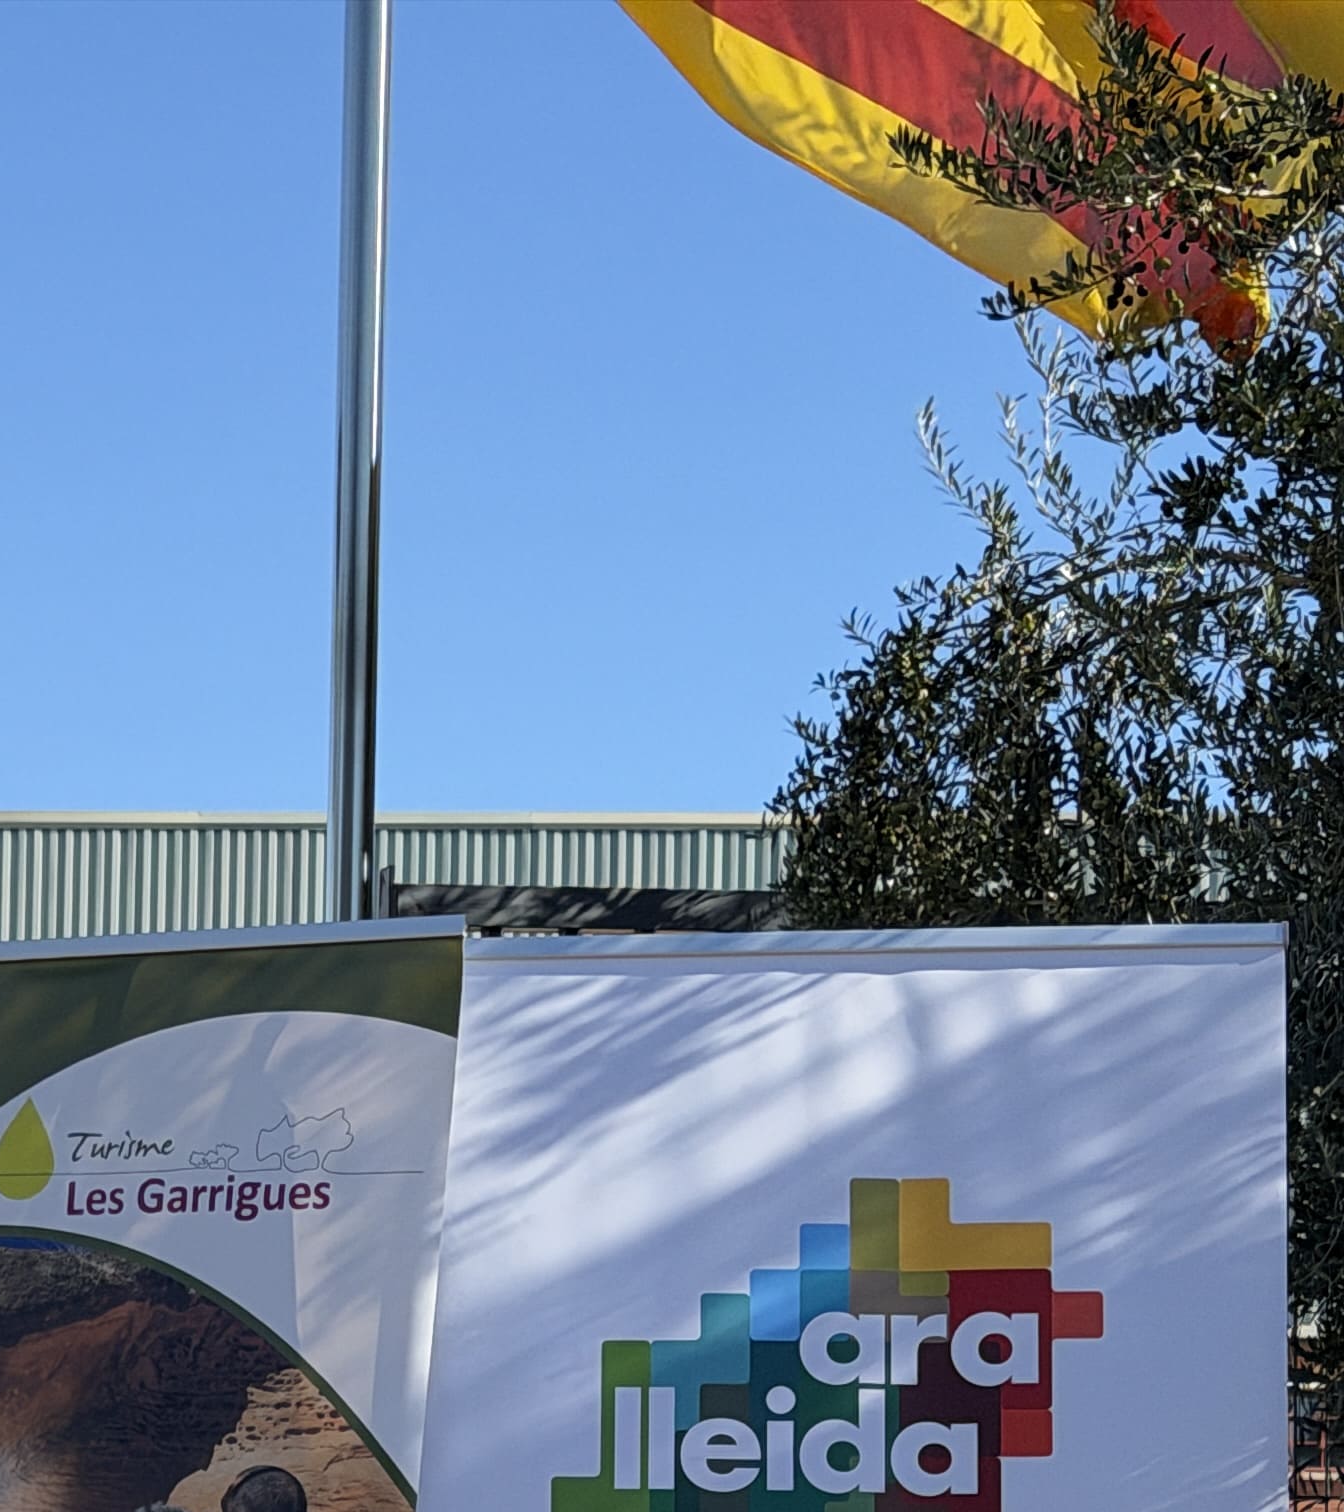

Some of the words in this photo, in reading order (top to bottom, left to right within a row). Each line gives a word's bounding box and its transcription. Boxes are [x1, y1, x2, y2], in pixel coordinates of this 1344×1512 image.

[67, 1130, 175, 1161] Turisme
[66, 1179, 124, 1217] Les
[137, 1174, 331, 1221] Garrigues
[799, 1310, 1039, 1387] ara
[613, 1385, 979, 1497] lleida
